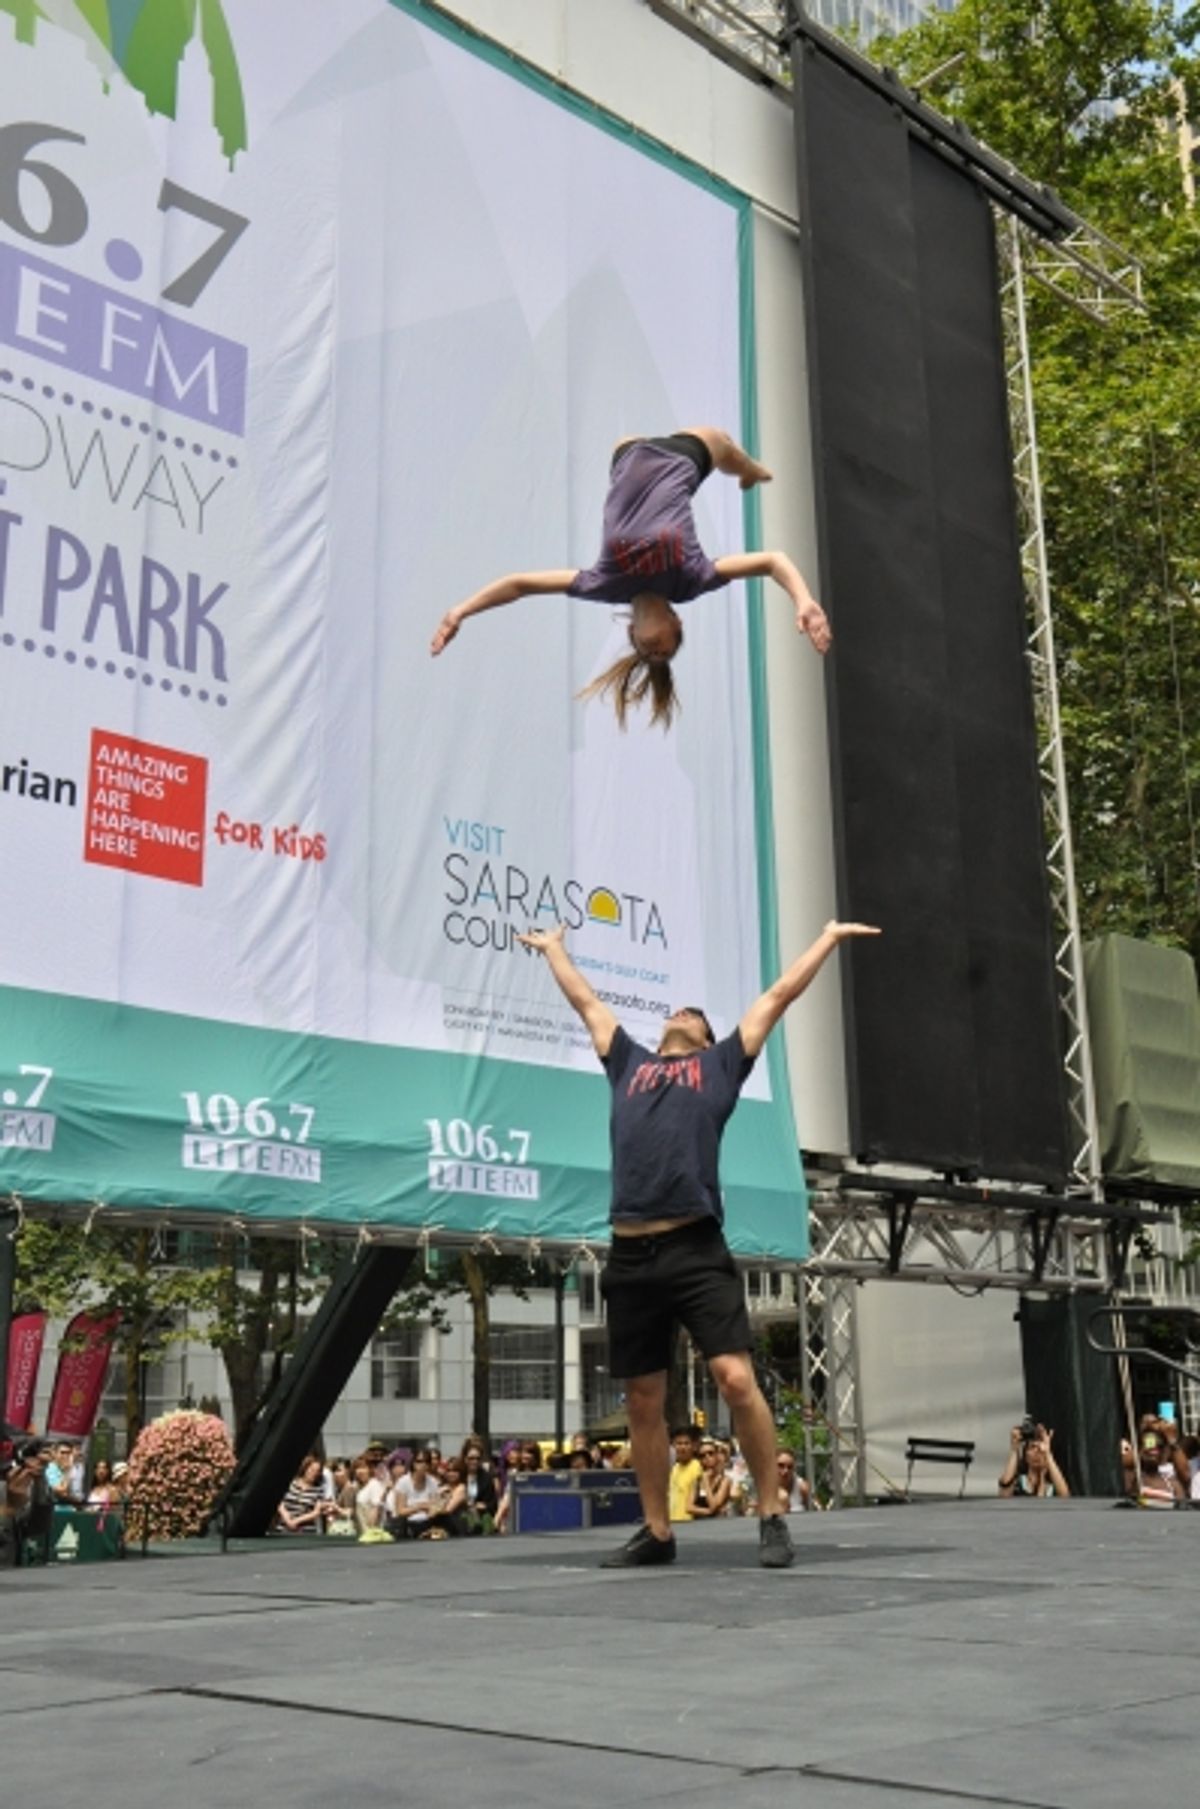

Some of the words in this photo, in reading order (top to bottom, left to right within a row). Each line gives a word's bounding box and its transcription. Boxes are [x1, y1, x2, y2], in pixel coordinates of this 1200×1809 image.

[40, 524, 230, 683] PARK
[1, 758, 78, 807] rian
[96, 744, 189, 784] AMAZING
[96, 765, 165, 801] THINGS
[93, 787, 131, 813] ARE
[89, 830, 138, 859] HERE
[90, 808, 201, 851] HAPPENING
[444, 816, 506, 855] VISIT
[443, 852, 669, 950] SARASOTA
[180, 1091, 316, 1144] 106.7
[424, 1117, 531, 1164] 106.7
